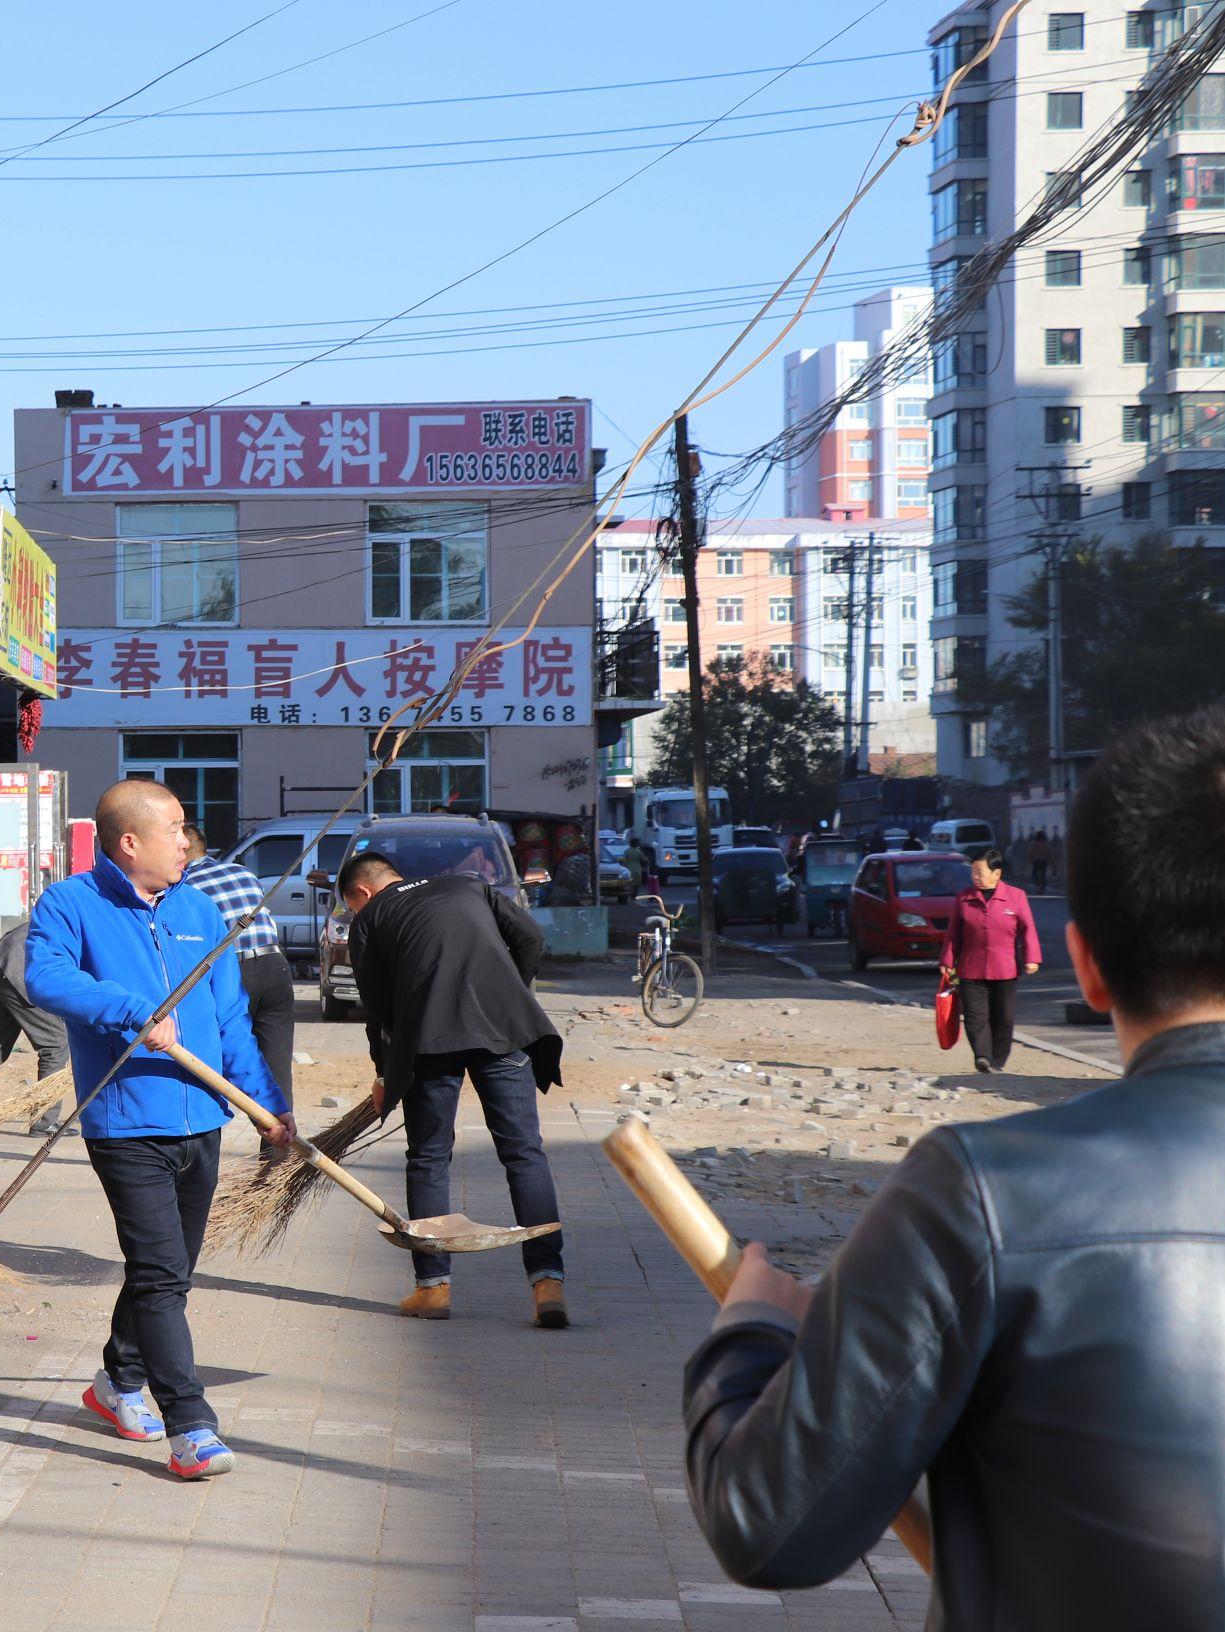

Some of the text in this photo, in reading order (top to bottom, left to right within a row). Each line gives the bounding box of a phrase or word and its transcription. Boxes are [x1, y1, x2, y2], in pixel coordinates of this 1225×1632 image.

[482, 410, 575, 447] 联系电话
[76, 410, 466, 488] 宏利涂料厂
[426, 452, 579, 484] 15636568844
[56, 636, 576, 700] 李春福盲人按摩院
[340, 704, 392, 723] 136
[503, 704, 576, 723] 7868
[180, 933, 203, 942] Columbia
